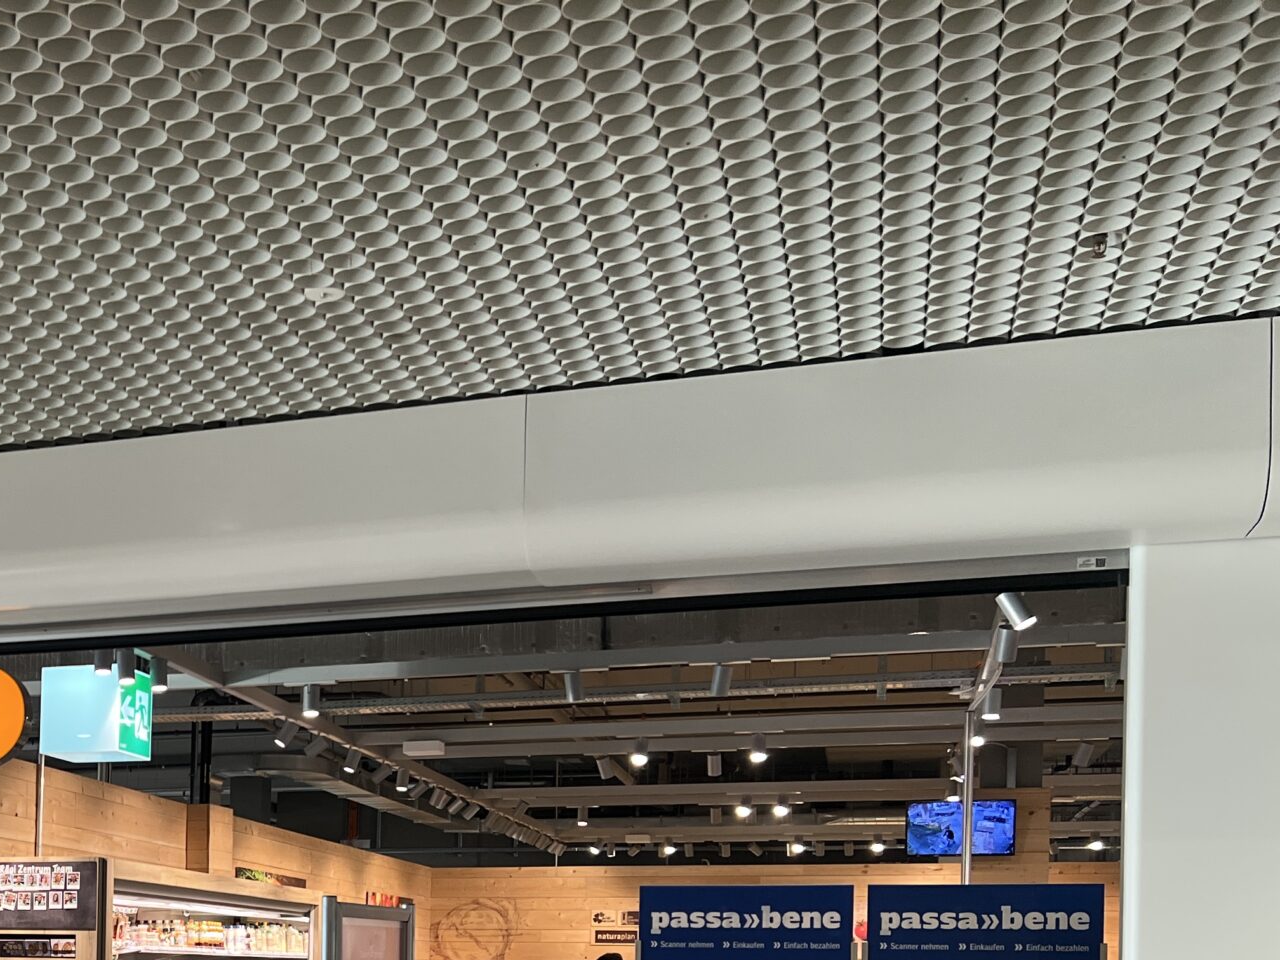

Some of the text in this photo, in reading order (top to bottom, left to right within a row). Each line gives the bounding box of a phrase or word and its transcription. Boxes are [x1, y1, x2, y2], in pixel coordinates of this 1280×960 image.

[597, 932, 636, 941] naturaplan
[660, 941, 687, 949] Scanner
[732, 941, 765, 950] Einkaufen
[783, 942, 809, 950] Einfach
[890, 942, 1090, 953] Scanner nehmen Einkaufen Einfach bezahlen
